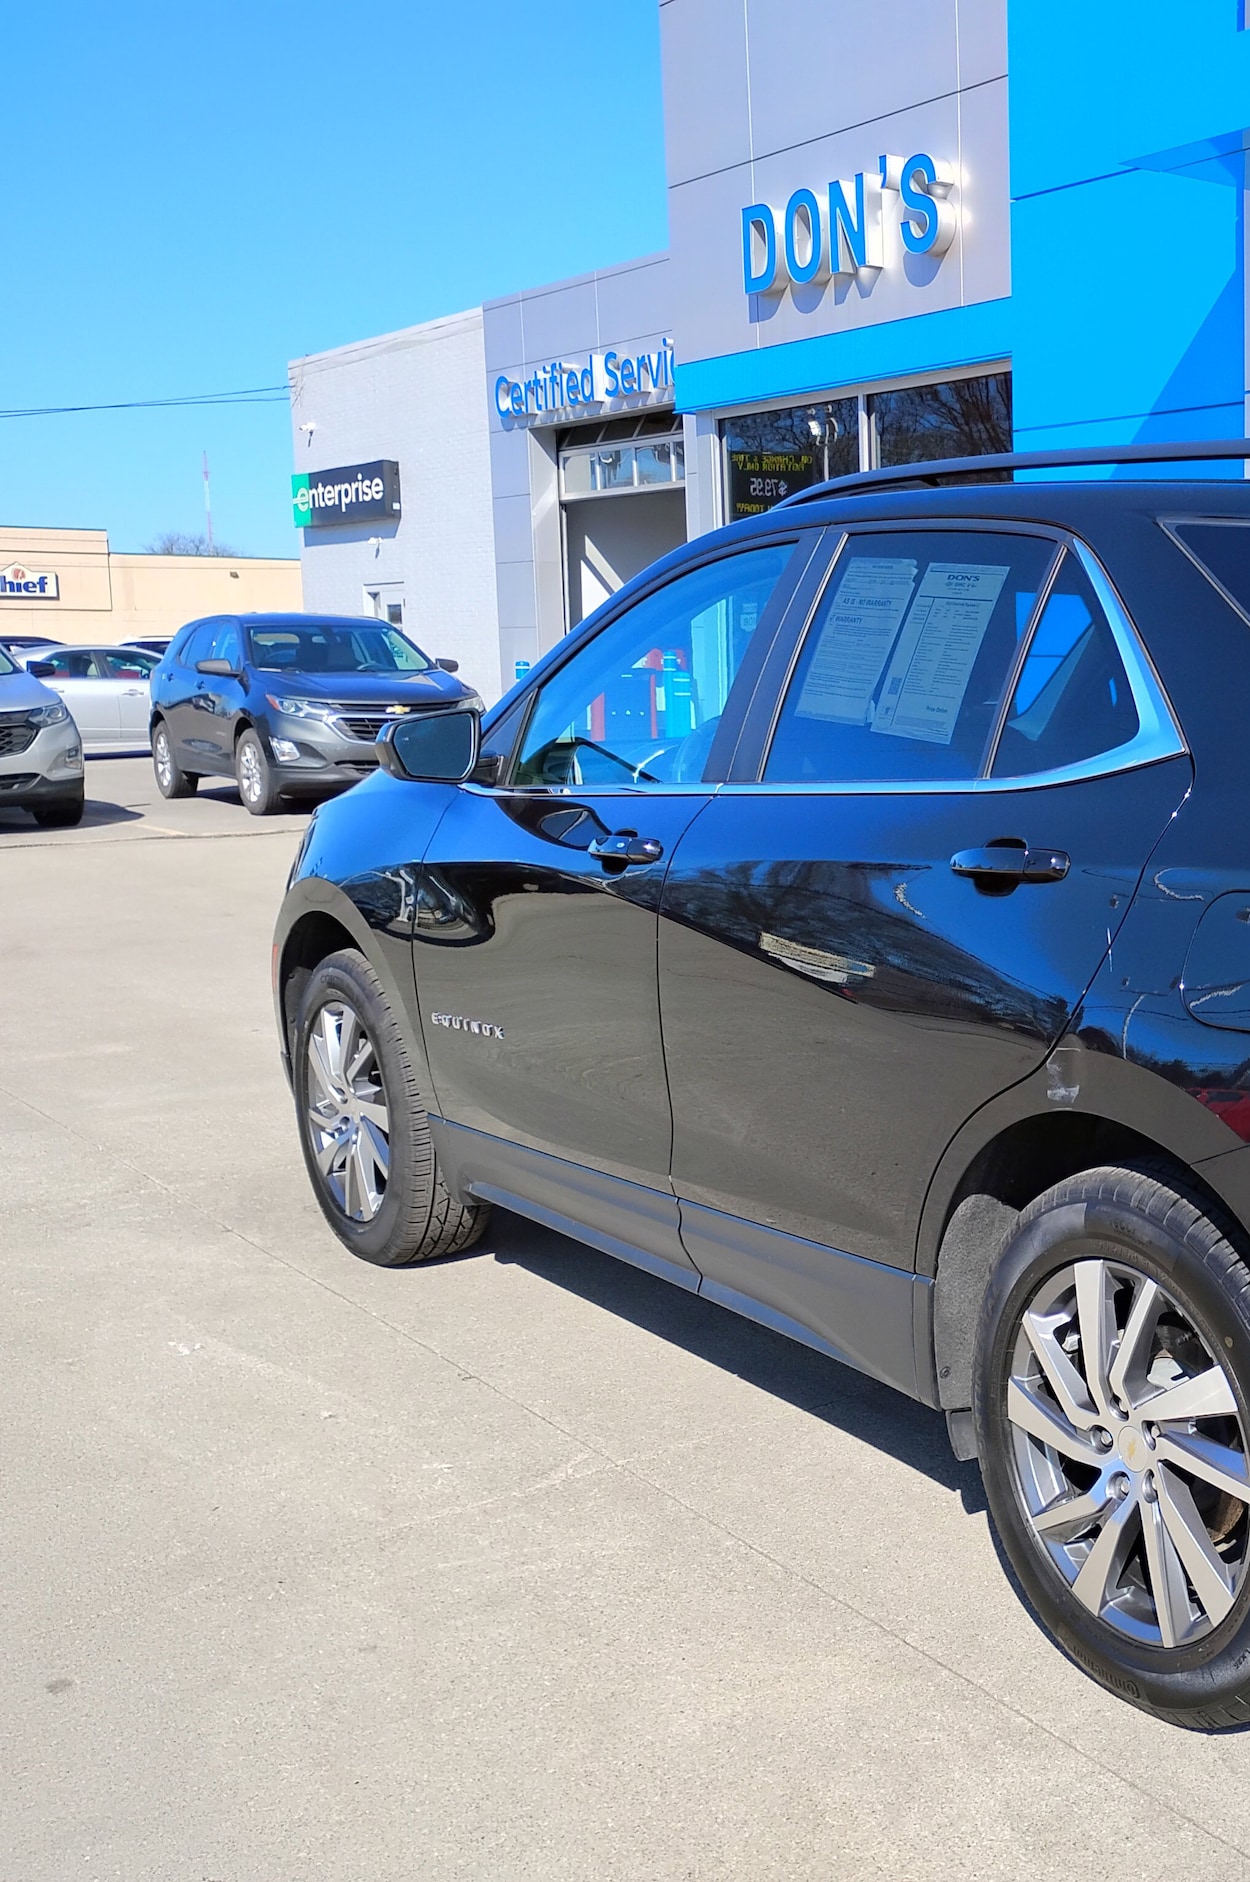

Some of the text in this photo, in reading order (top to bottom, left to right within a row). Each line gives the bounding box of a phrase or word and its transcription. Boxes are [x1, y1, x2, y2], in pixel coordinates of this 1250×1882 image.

[741, 153, 940, 295] DON'S
[494, 354, 596, 419] Certified
[293, 472, 384, 513] enterprise
[947, 574, 981, 582] DON'S
[431, 1012, 505, 1040] EQUINOX
